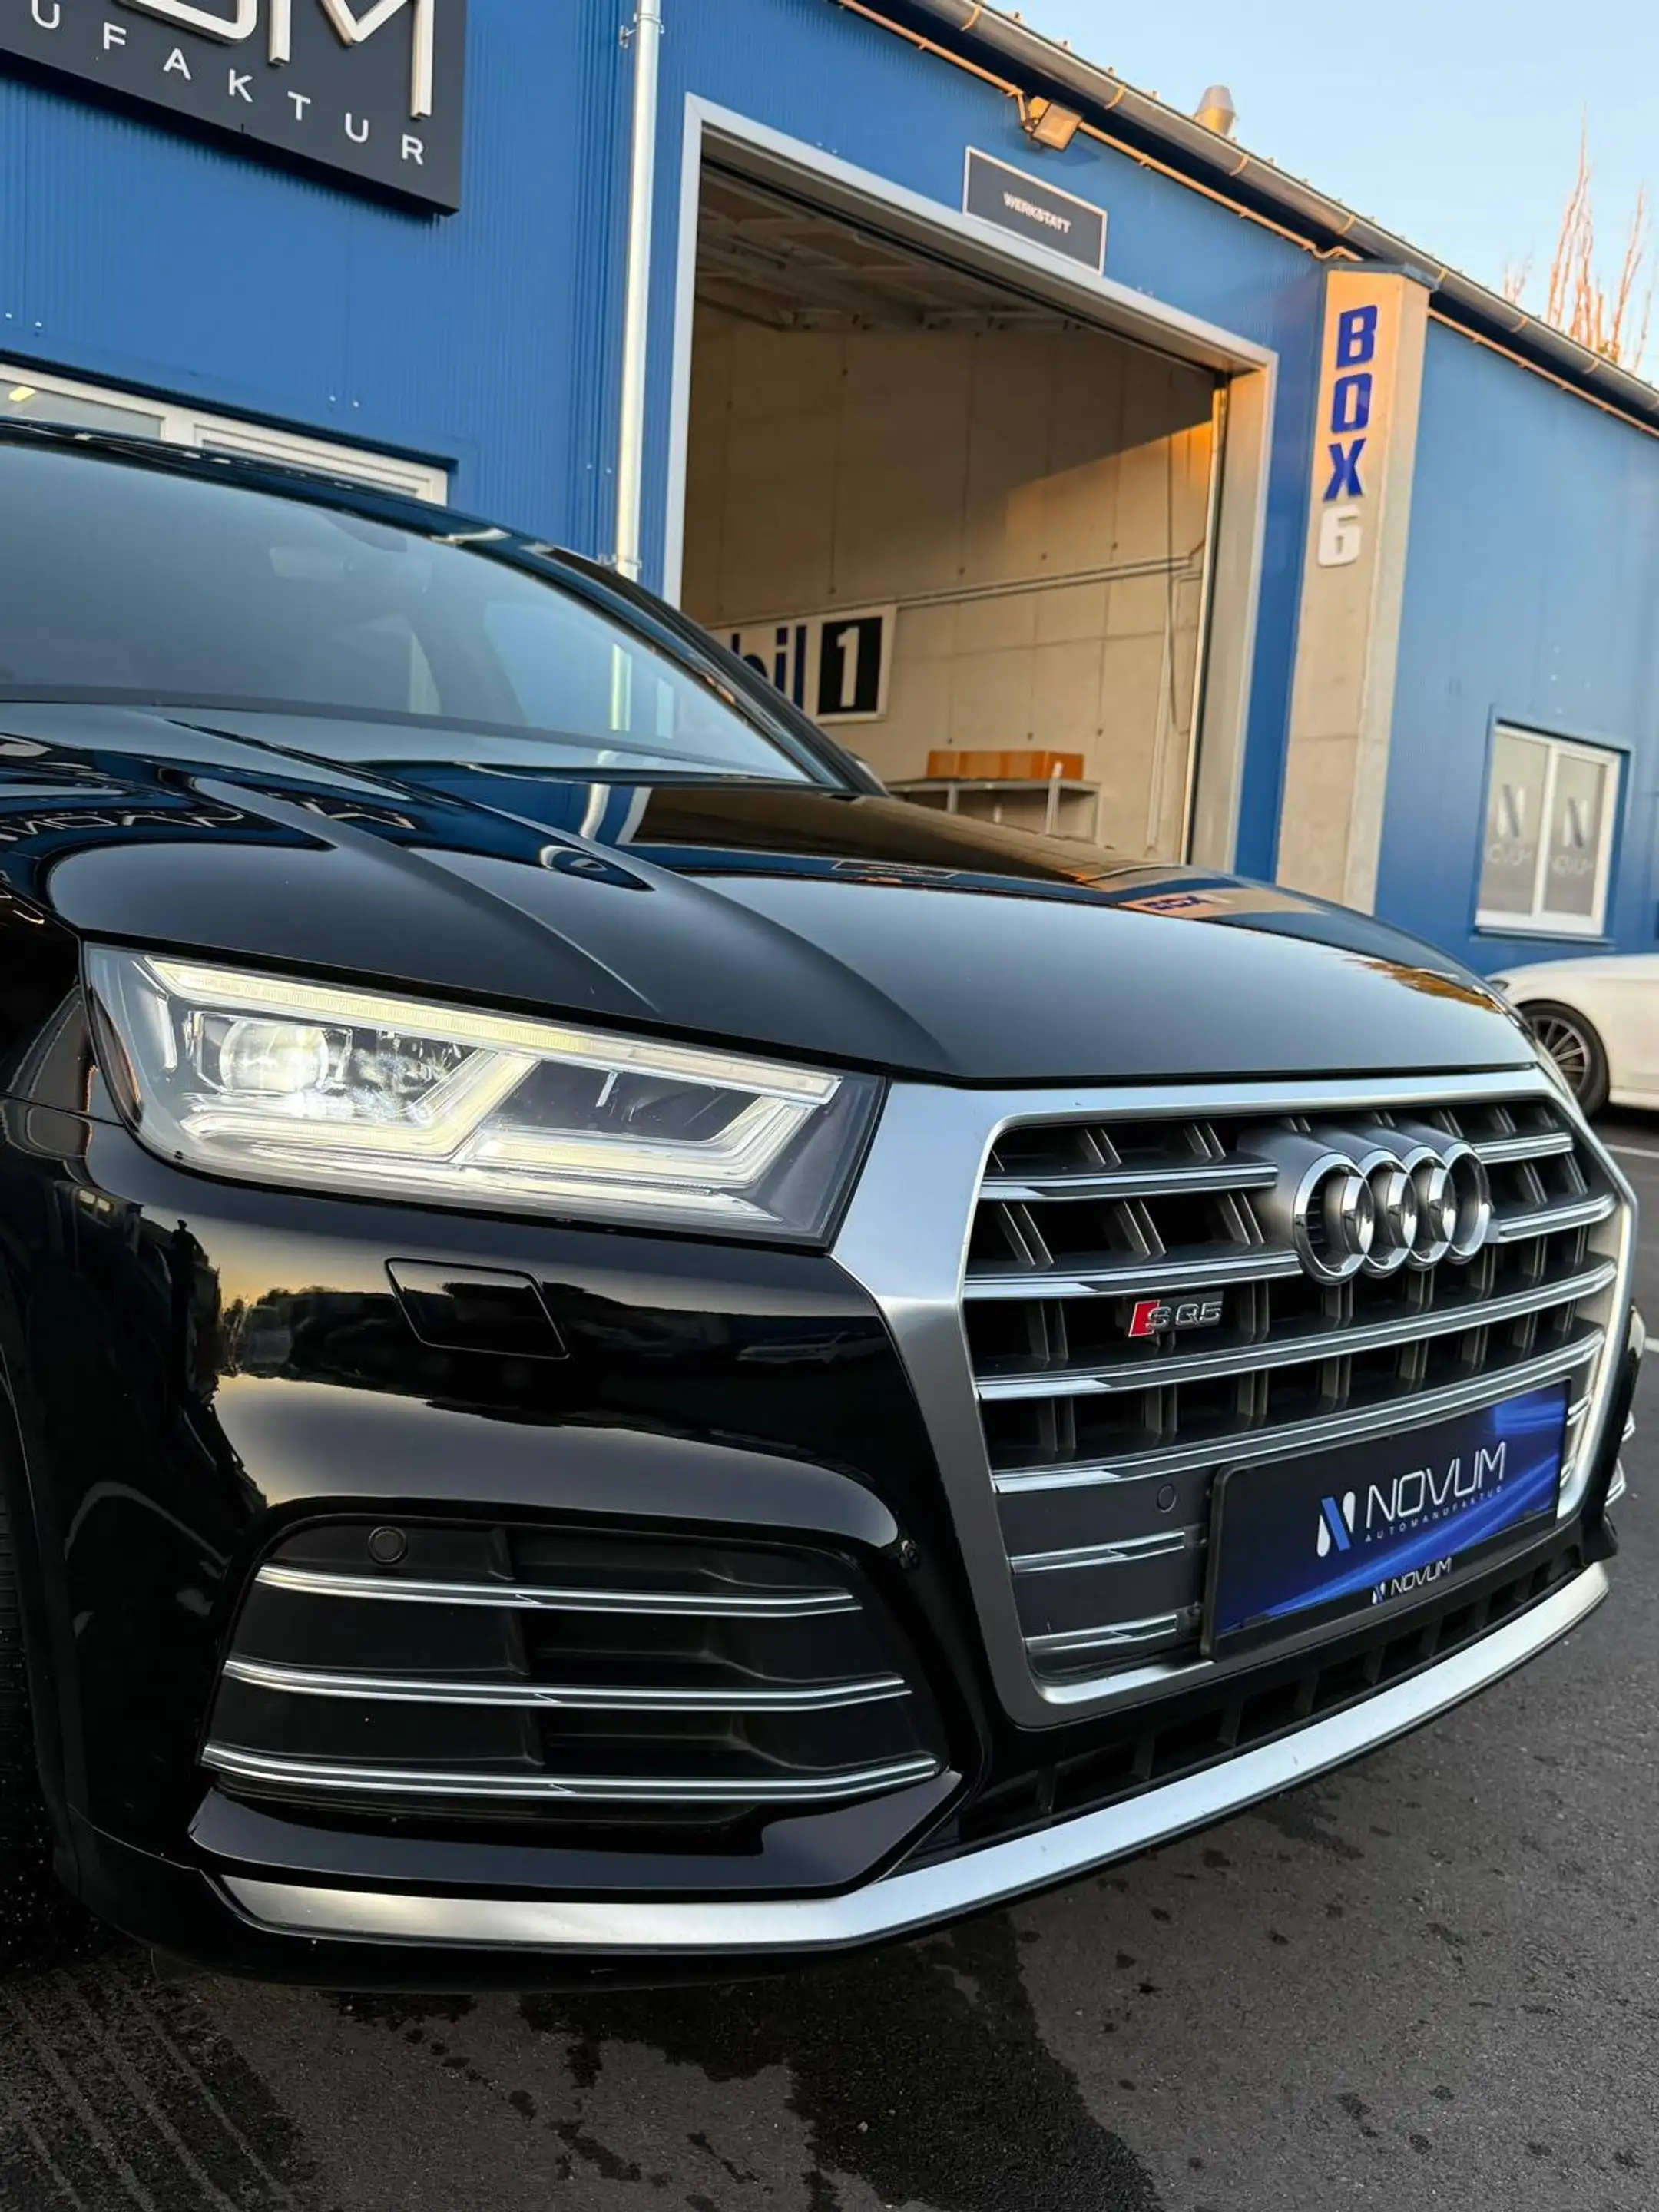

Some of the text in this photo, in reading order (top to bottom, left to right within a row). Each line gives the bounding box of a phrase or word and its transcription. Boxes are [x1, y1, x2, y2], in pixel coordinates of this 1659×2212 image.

[1003, 192, 1071, 233] WERKSTATT
[1316, 305, 1378, 568] BOX 6
[837, 626, 860, 707] 1
[1144, 1300, 1223, 1330] SQ5
[1365, 1485, 1502, 1543] AUTOMANUFAKTUR
[1366, 1441, 1506, 1529] NOVUM
[1390, 1556, 1452, 1596] NOVUM
